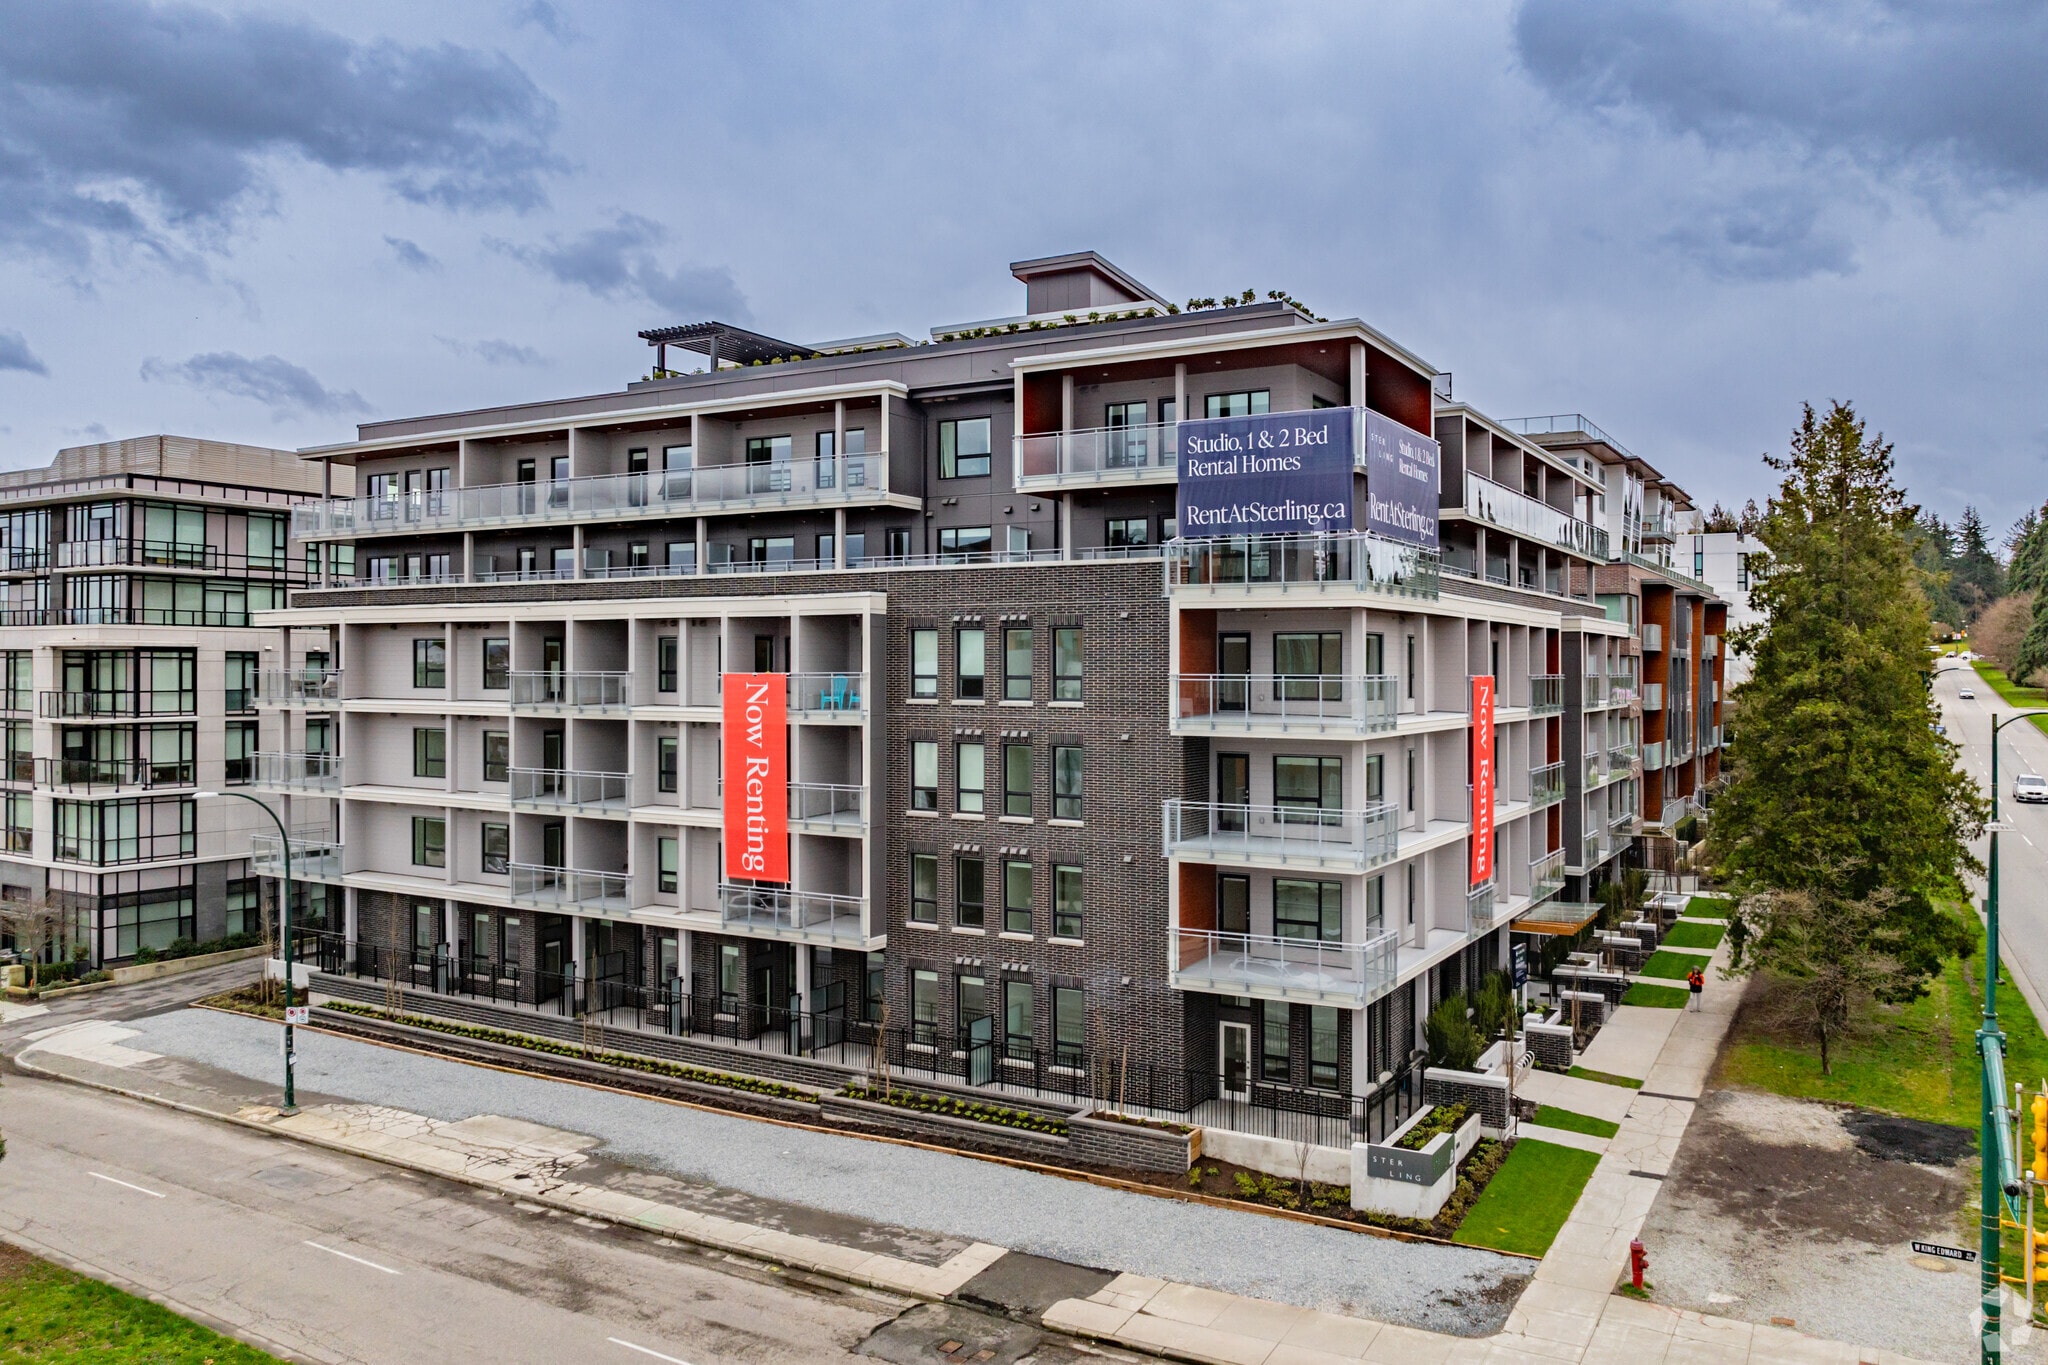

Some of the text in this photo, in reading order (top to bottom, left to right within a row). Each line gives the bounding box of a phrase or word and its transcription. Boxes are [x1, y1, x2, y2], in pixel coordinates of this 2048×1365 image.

[1187, 425, 1329, 454] Studio, 1 & 2 Bed
[1188, 455, 1301, 477] Rental Homes
[1399, 457, 1429, 483] Rental Homes
[1187, 500, 1346, 526] RentAtSterling.ca
[1370, 492, 1435, 541] RentAtSterling.ca
[741, 682, 769, 873] Now Renting
[1476, 685, 1489, 874] Now Renting
[1372, 1155, 1403, 1167] STER
[1389, 1170, 1421, 1182] LING
[1914, 1243, 1920, 1251] W
[1921, 1244, 1936, 1254] KING
[1936, 1247, 1962, 1258] EDWARD
